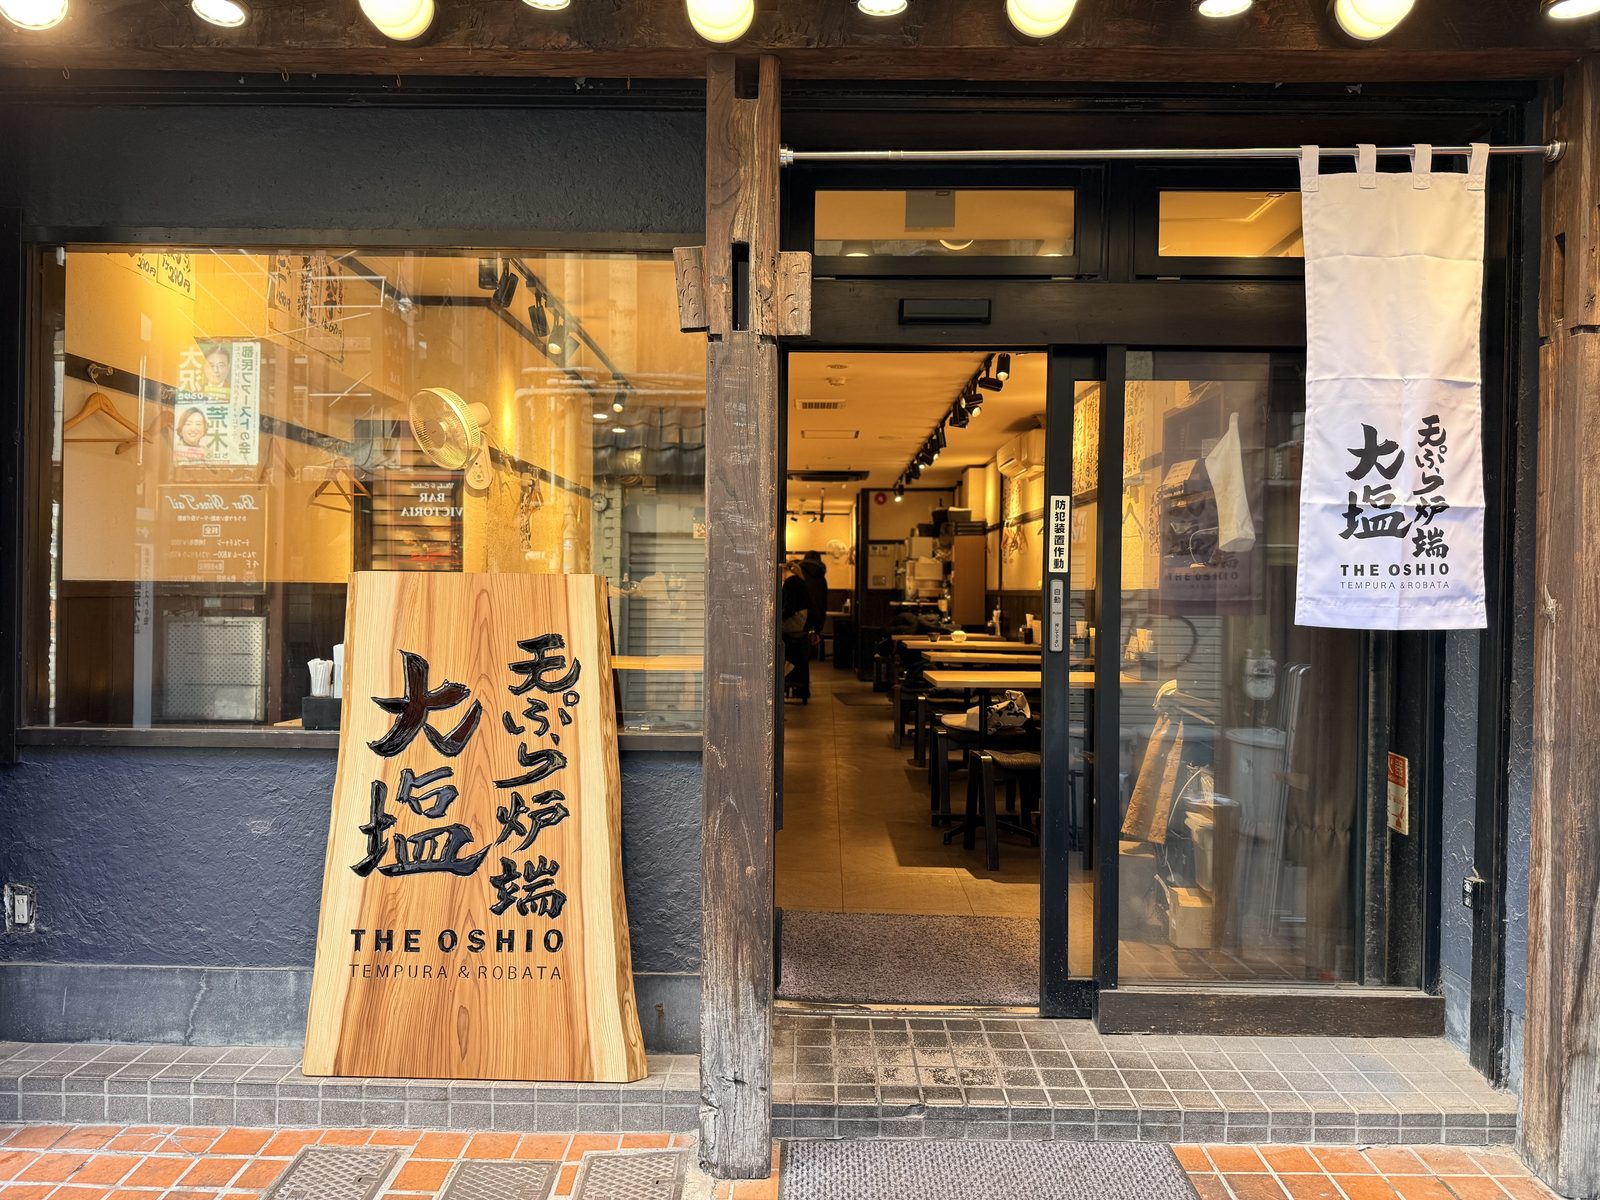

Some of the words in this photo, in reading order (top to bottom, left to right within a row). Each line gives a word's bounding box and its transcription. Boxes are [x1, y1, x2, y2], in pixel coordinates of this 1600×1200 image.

[1338, 423, 1412, 540] 大塩
[1053, 500, 1066, 570] 防犯装置作動
[1340, 563, 1380, 577] THE
[1388, 562, 1450, 576] OSHIO
[1340, 581, 1397, 590] TEMPURA
[1399, 581, 1406, 589] &
[1408, 581, 1450, 589] ROBATA
[350, 648, 491, 878] 大塩
[350, 928, 421, 953] THE
[438, 928, 565, 954] OSHIO
[349, 963, 448, 980] TEMPURA
[458, 965, 471, 980] &
[477, 965, 563, 981] ROBATA
